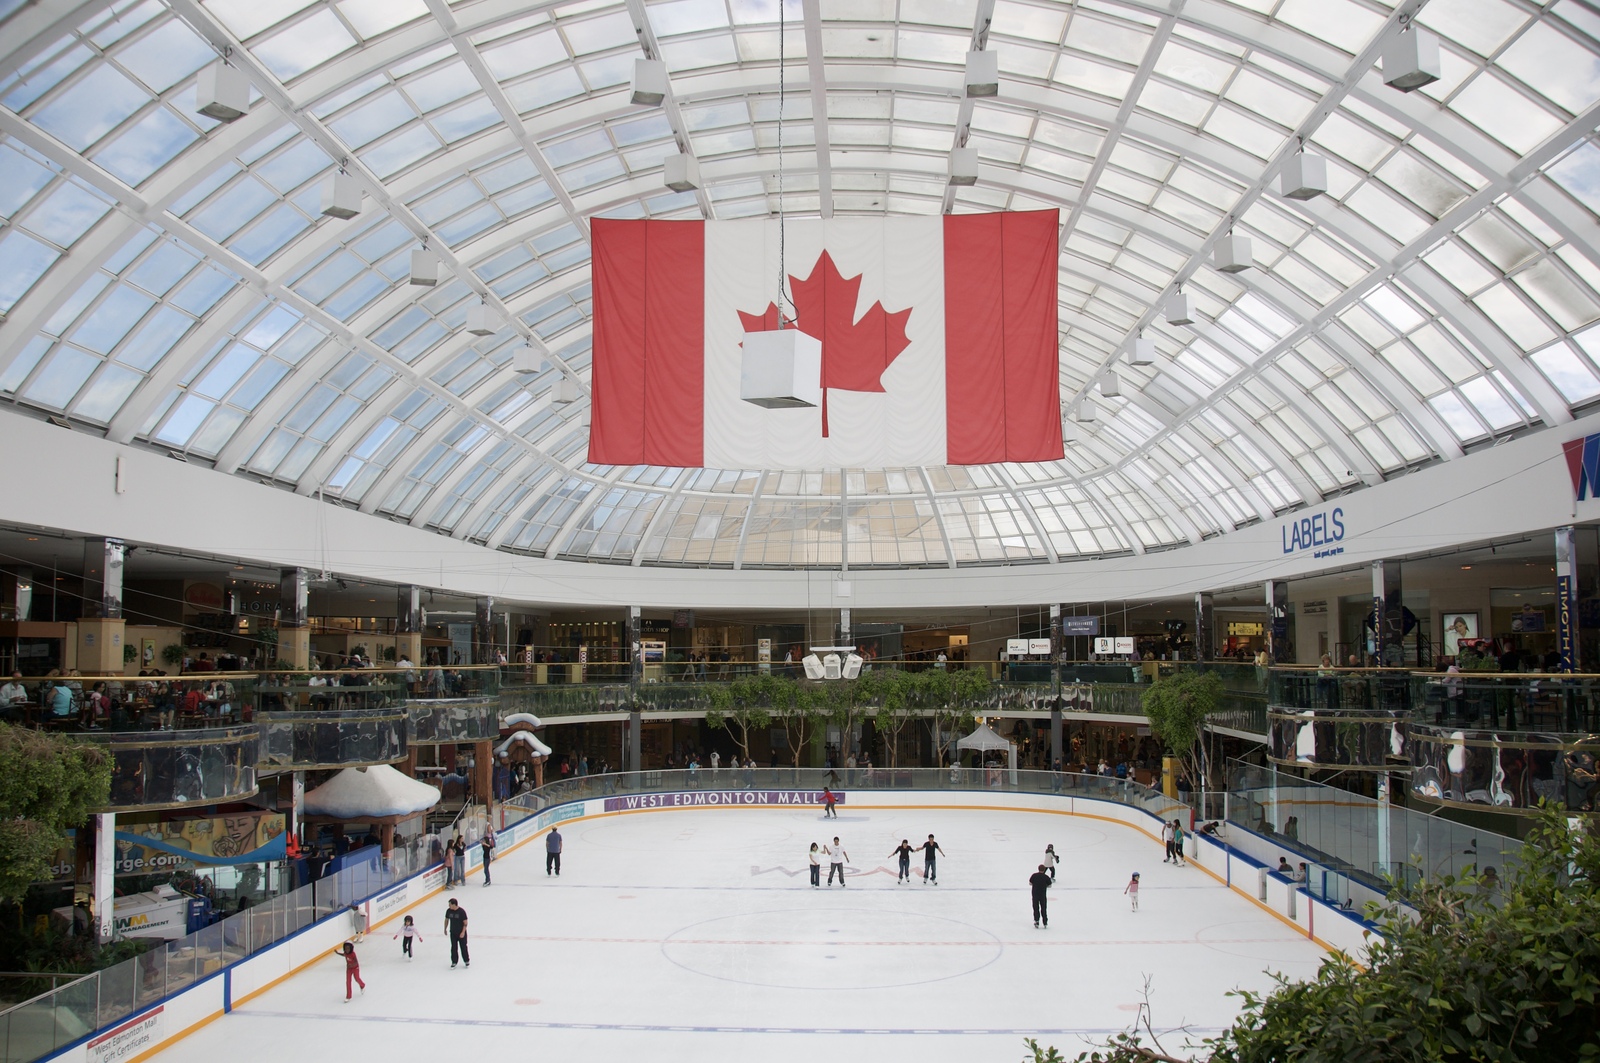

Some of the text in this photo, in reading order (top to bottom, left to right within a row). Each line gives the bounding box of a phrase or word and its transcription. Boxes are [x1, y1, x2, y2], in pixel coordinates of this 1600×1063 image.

[1282, 507, 1345, 554] LABELS
[450, 627, 469, 636] SALE
[626, 791, 819, 809] WEST EDMONTON MALL
[120, 920, 169, 933] MANAGEMENT
[94, 1041, 111, 1055] West
[112, 1025, 144, 1047] Edmonton
[144, 1016, 158, 1029] Mall
[103, 1033, 150, 1063] Gift Certificates
